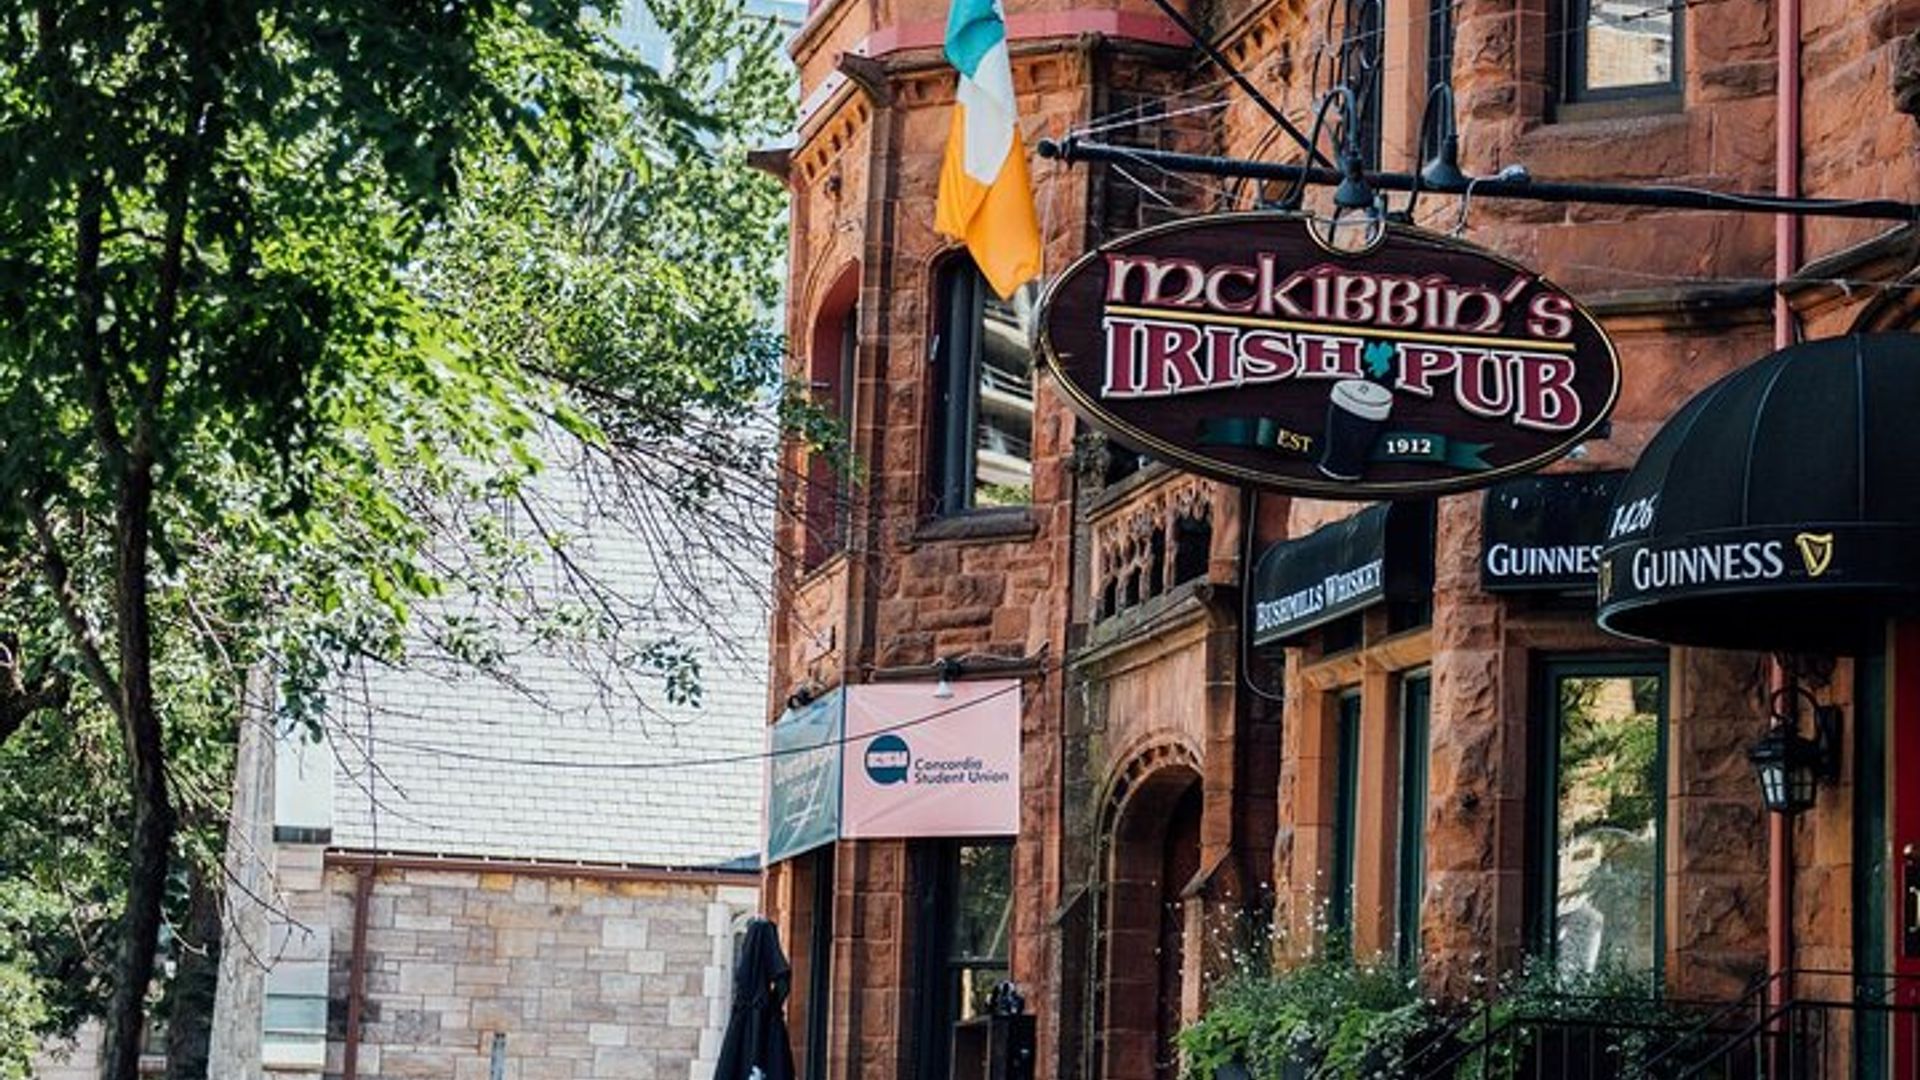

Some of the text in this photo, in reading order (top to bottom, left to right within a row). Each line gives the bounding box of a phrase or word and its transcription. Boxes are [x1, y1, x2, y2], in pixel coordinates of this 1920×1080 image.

[1102, 316, 1582, 430] IRISH PUB
[1277, 428, 1431, 454] EST 1912
[1608, 493, 1660, 540] 1426
[1487, 542, 1604, 576] GUINNES
[1632, 540, 1784, 590] GUINNESS
[1256, 558, 1383, 632] BUSHMILLS WHISKEY
[915, 756, 983, 771] Concordia
[915, 769, 1010, 785] Student Union
